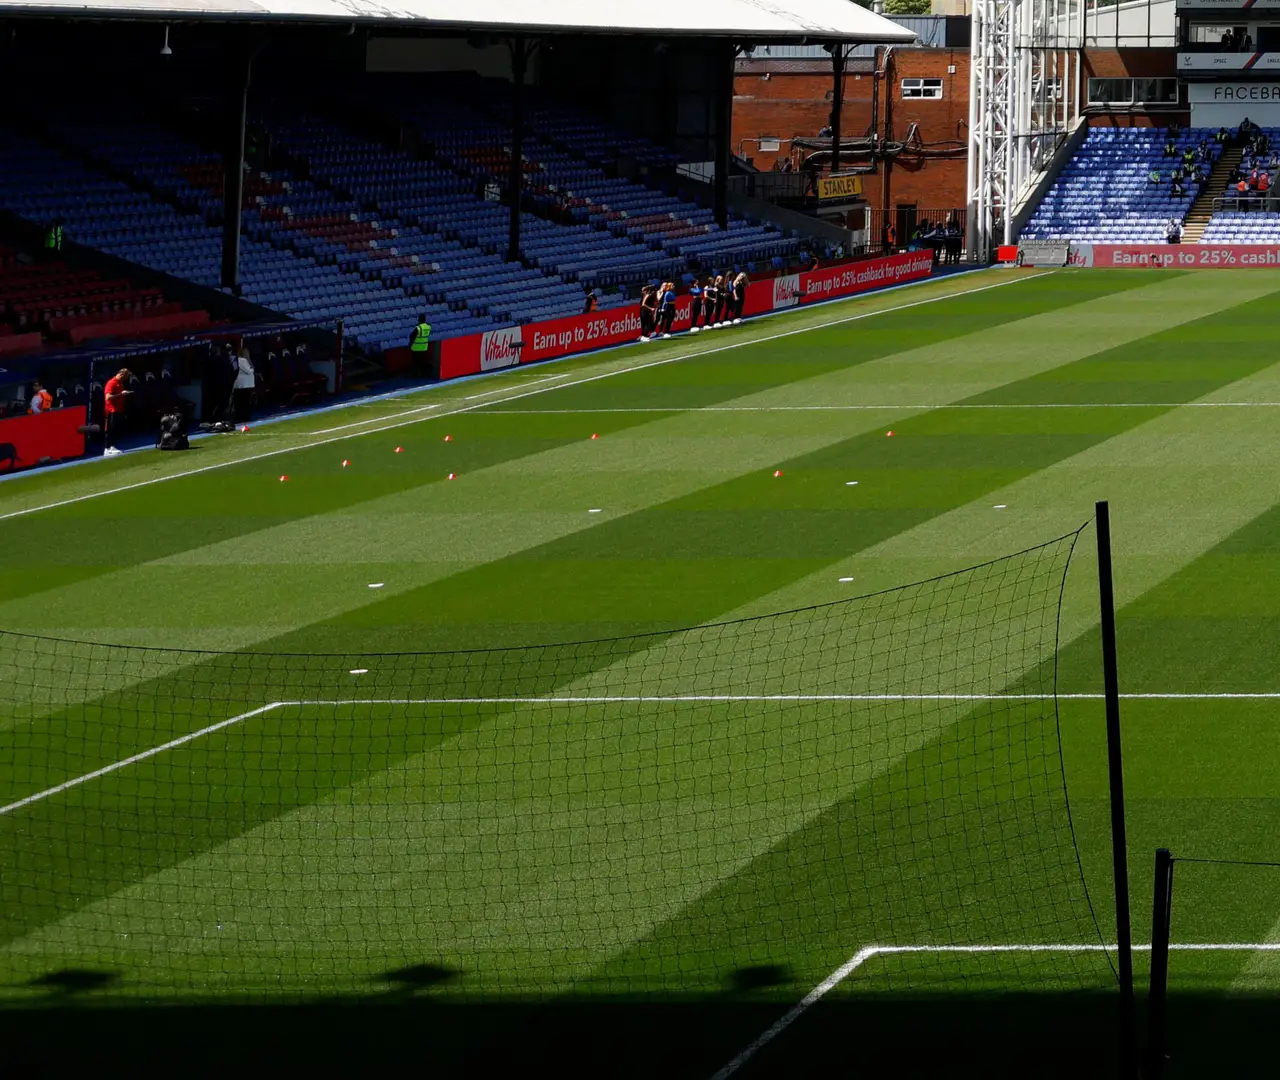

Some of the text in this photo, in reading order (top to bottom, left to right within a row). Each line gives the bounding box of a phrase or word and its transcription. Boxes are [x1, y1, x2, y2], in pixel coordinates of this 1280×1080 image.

[824, 178, 856, 196] STANLEY
[1113, 250, 1148, 264] Earn
[1178, 252, 1195, 264] to
[1200, 250, 1236, 264] 25%
[806, 256, 932, 295] Earn up to 25% cashback for good driving
[533, 331, 557, 350] Earn
[559, 331, 573, 348] up
[573, 327, 585, 343] to
[586, 318, 609, 340] 25%
[610, 312, 642, 336] cashba
